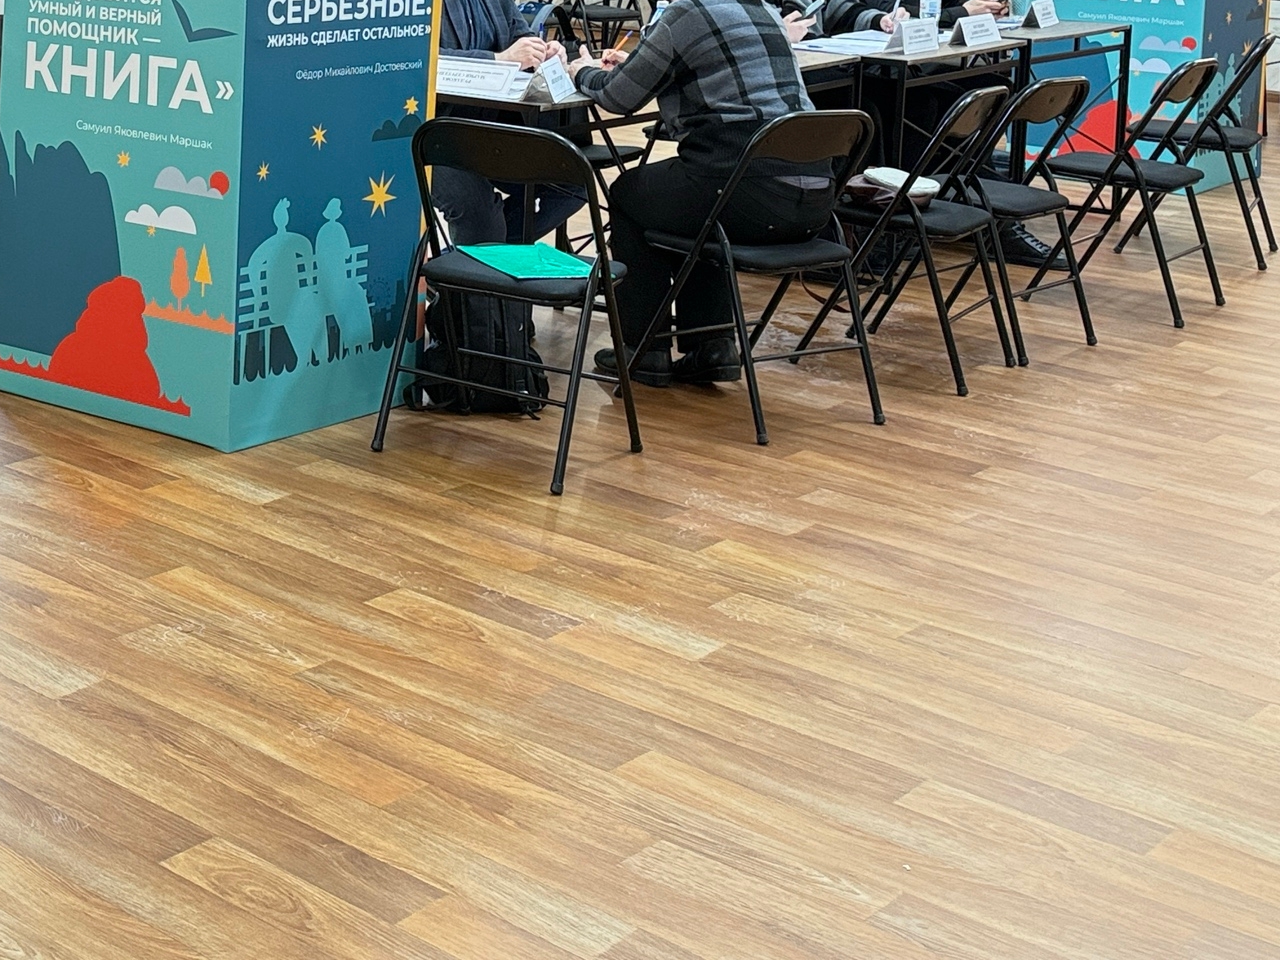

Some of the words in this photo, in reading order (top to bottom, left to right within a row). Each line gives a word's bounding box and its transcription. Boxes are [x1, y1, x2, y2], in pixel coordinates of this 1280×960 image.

[85, 4, 95, 19] И
[99, 5, 162, 25] ВЕРНЫЙ
[1078, 11, 1107, 20] Самуил
[1151, 17, 1184, 26] Маршак
[27, 17, 138, 46] ПОМОЩНИК
[267, 33, 308, 48] ЖИЗНЬ
[311, 29, 360, 45] СДЕЛАЕТ
[363, 24, 431, 40] ОСТАЛЬНОЕ»
[24, 40, 235, 114] КНИГА»
[296, 69, 323, 80] Фёдор
[325, 65, 373, 77] Михайлович
[374, 59, 423, 74] Достоевский
[76, 118, 112, 135] Самуил
[114, 124, 168, 143] Яковлевич
[170, 133, 213, 150] Маршак
